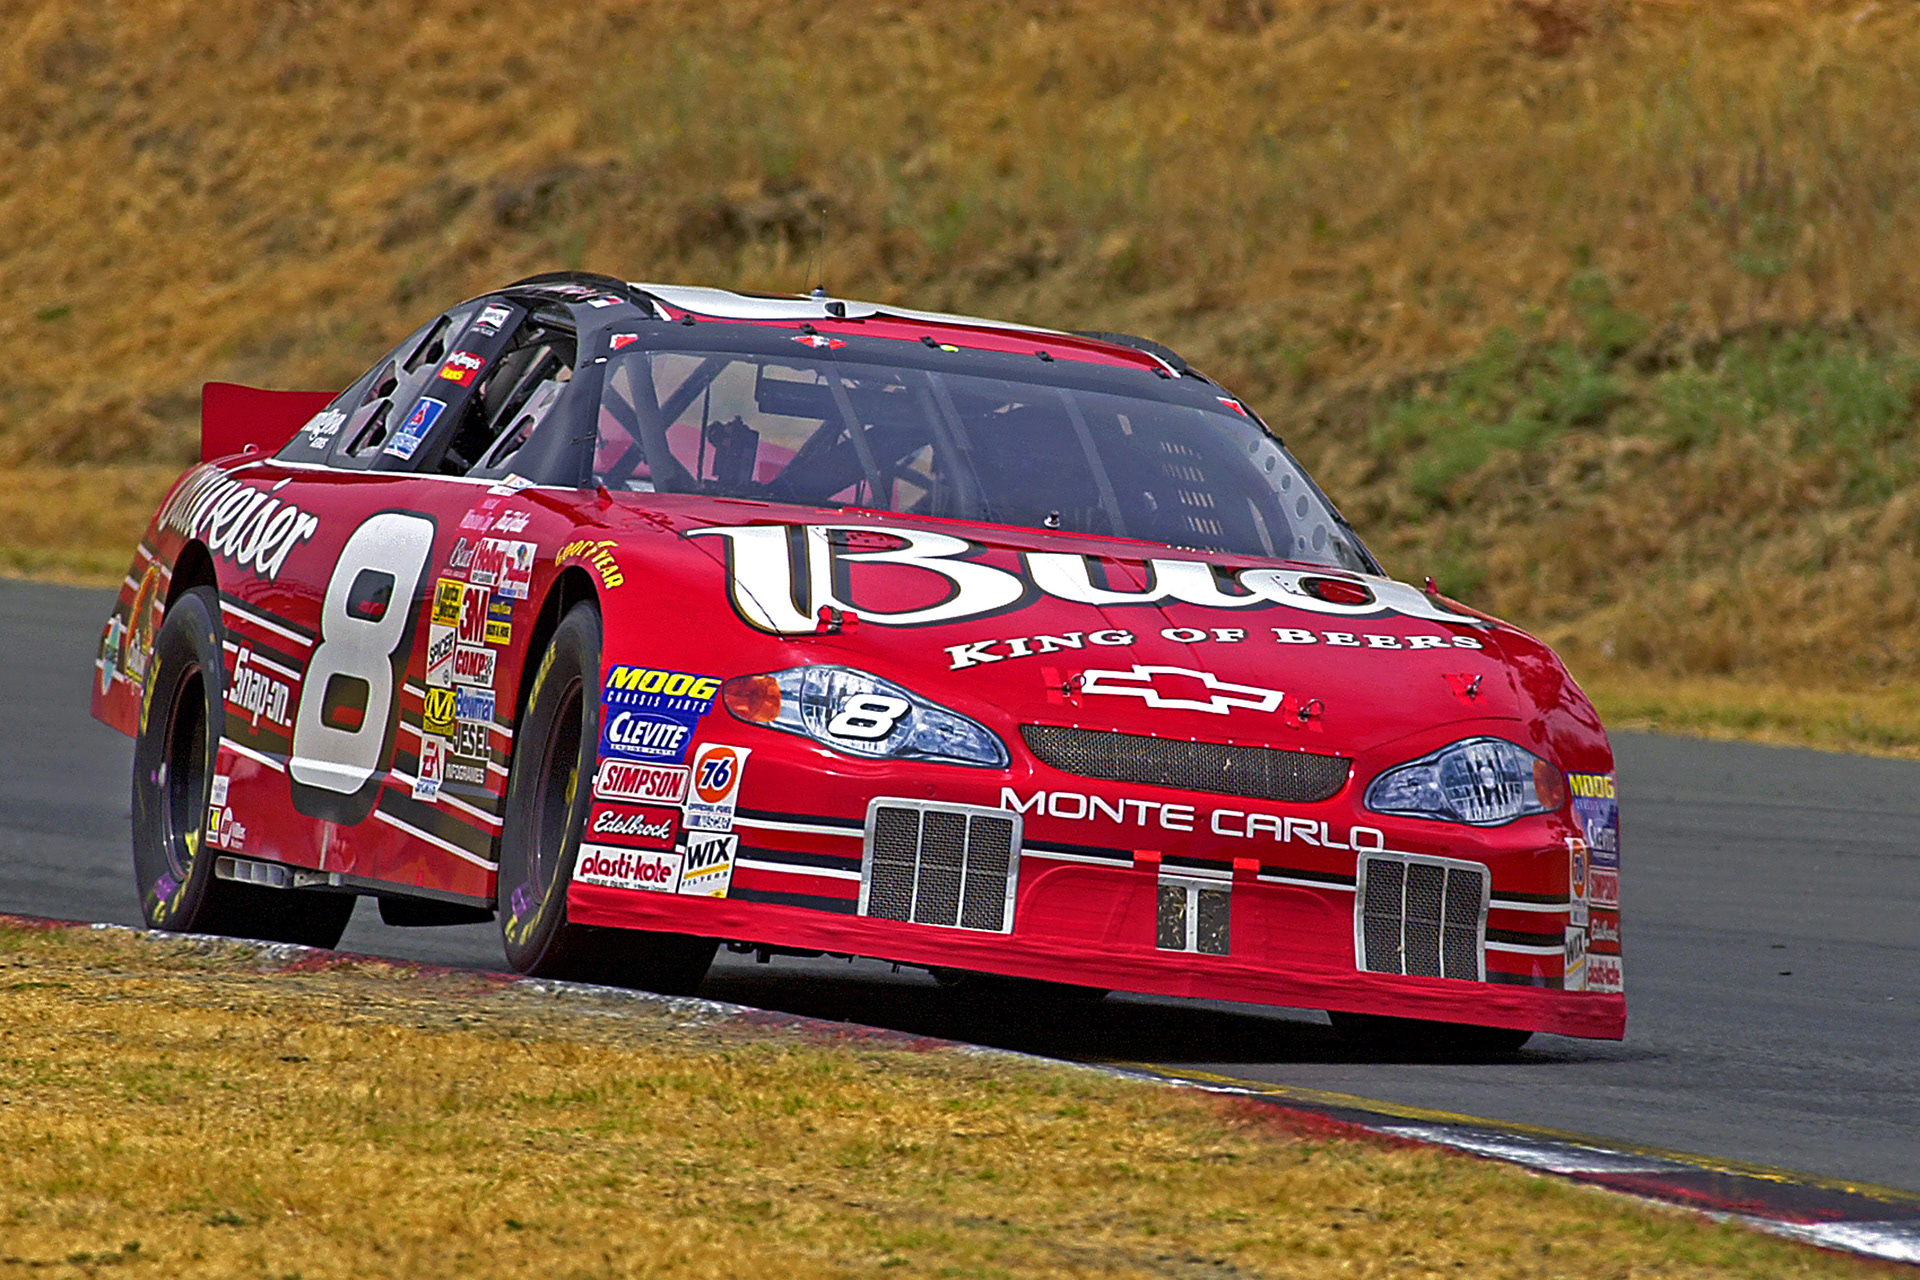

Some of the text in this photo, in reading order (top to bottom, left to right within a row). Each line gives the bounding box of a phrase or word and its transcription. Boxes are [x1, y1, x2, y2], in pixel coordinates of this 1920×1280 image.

[686, 524, 1484, 636] Bud
[460, 588, 488, 642] 3M
[289, 512, 435, 795] 8
[455, 650, 487, 676] COMP
[945, 627, 1484, 670] KING OF BEERS
[606, 666, 721, 699] MOOG
[607, 690, 707, 713] CHASSIS PARTS
[828, 694, 913, 742] 8
[453, 722, 491, 760] JESEL
[609, 711, 688, 748] CLEVITE
[603, 765, 684, 798] SIMPSON
[698, 756, 735, 791] 76
[1568, 774, 1615, 799] MOOG
[593, 810, 672, 839] Edelbrock
[1000, 787, 1385, 852] MONTE CARLO
[580, 850, 672, 883] plasti-kote
[688, 837, 733, 870] WIX
